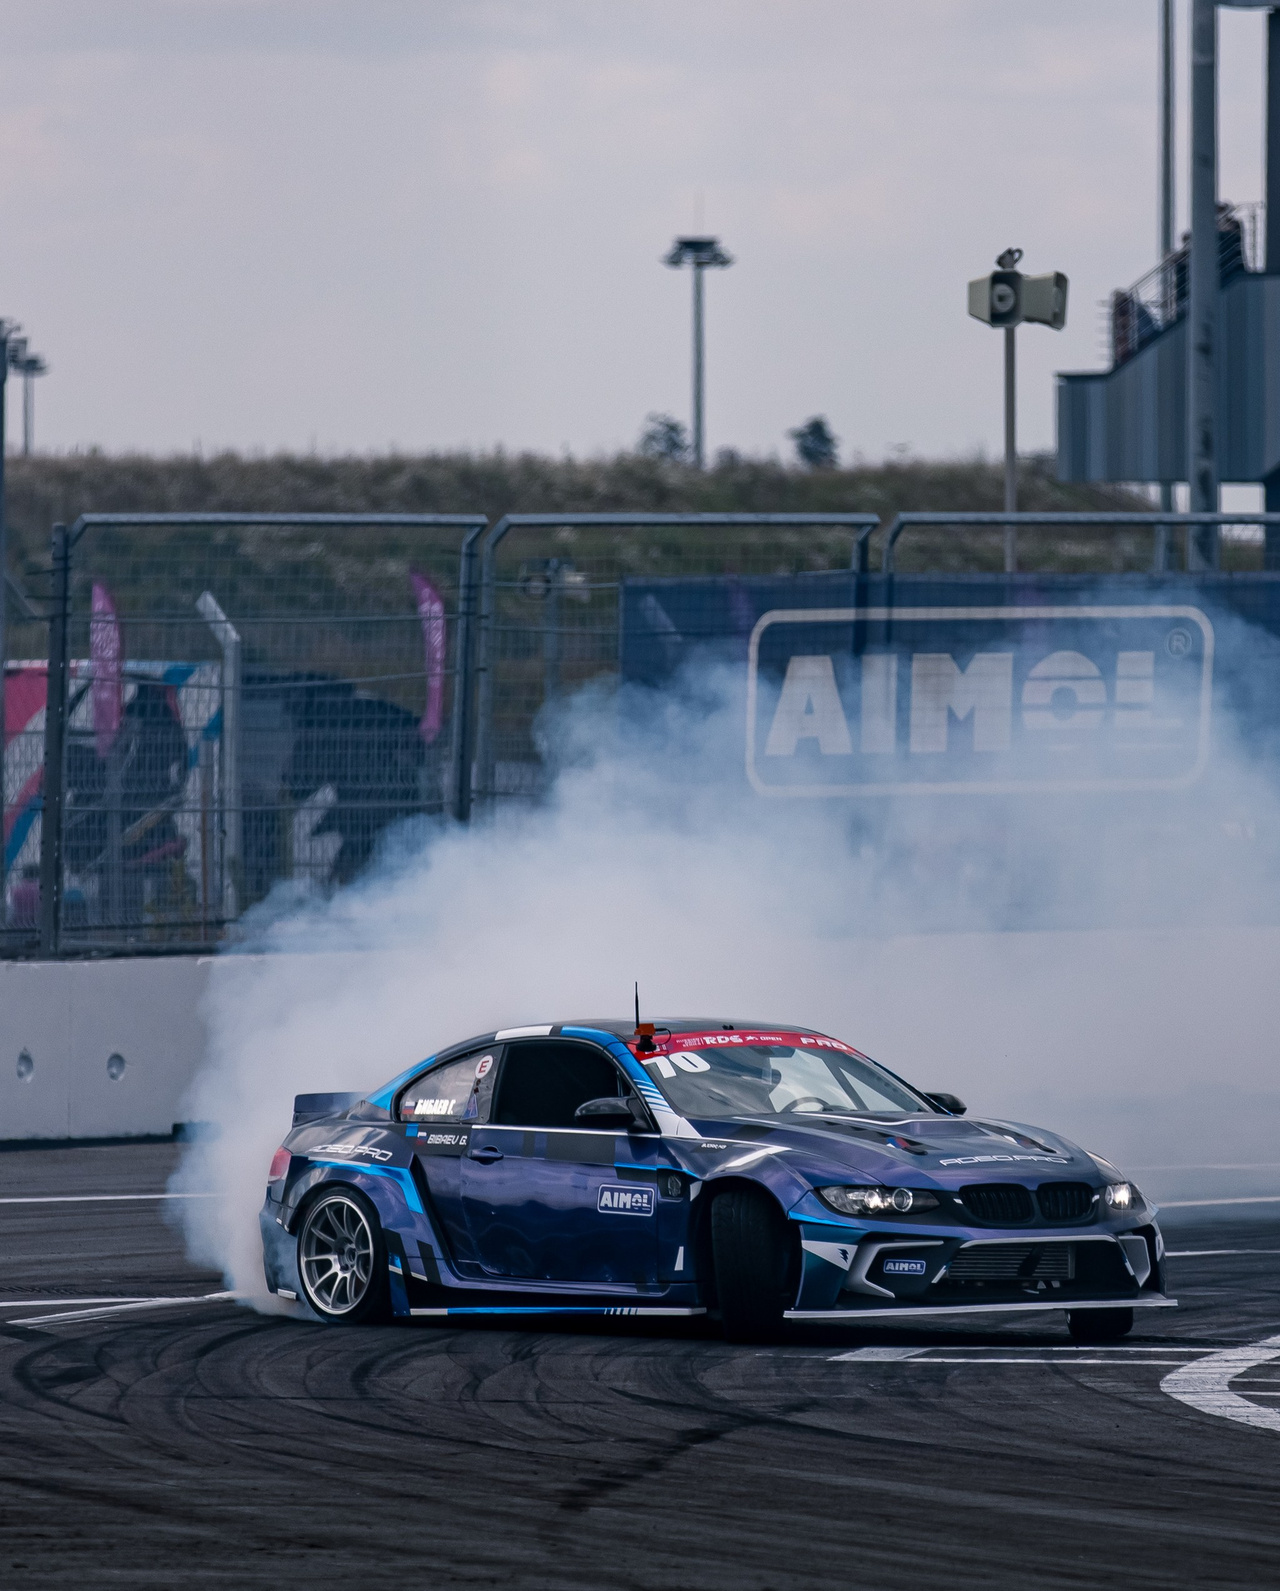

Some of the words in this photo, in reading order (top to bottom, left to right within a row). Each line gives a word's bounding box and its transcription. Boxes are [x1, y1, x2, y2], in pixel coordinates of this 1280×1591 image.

[764, 650, 1183, 755] AIMOL
[703, 1035, 744, 1045] RDS
[640, 1051, 711, 1079] 70
[427, 1134, 460, 1145] BIBAEV
[599, 1190, 651, 1211] AIMOL
[885, 1262, 923, 1272] AIMOL
